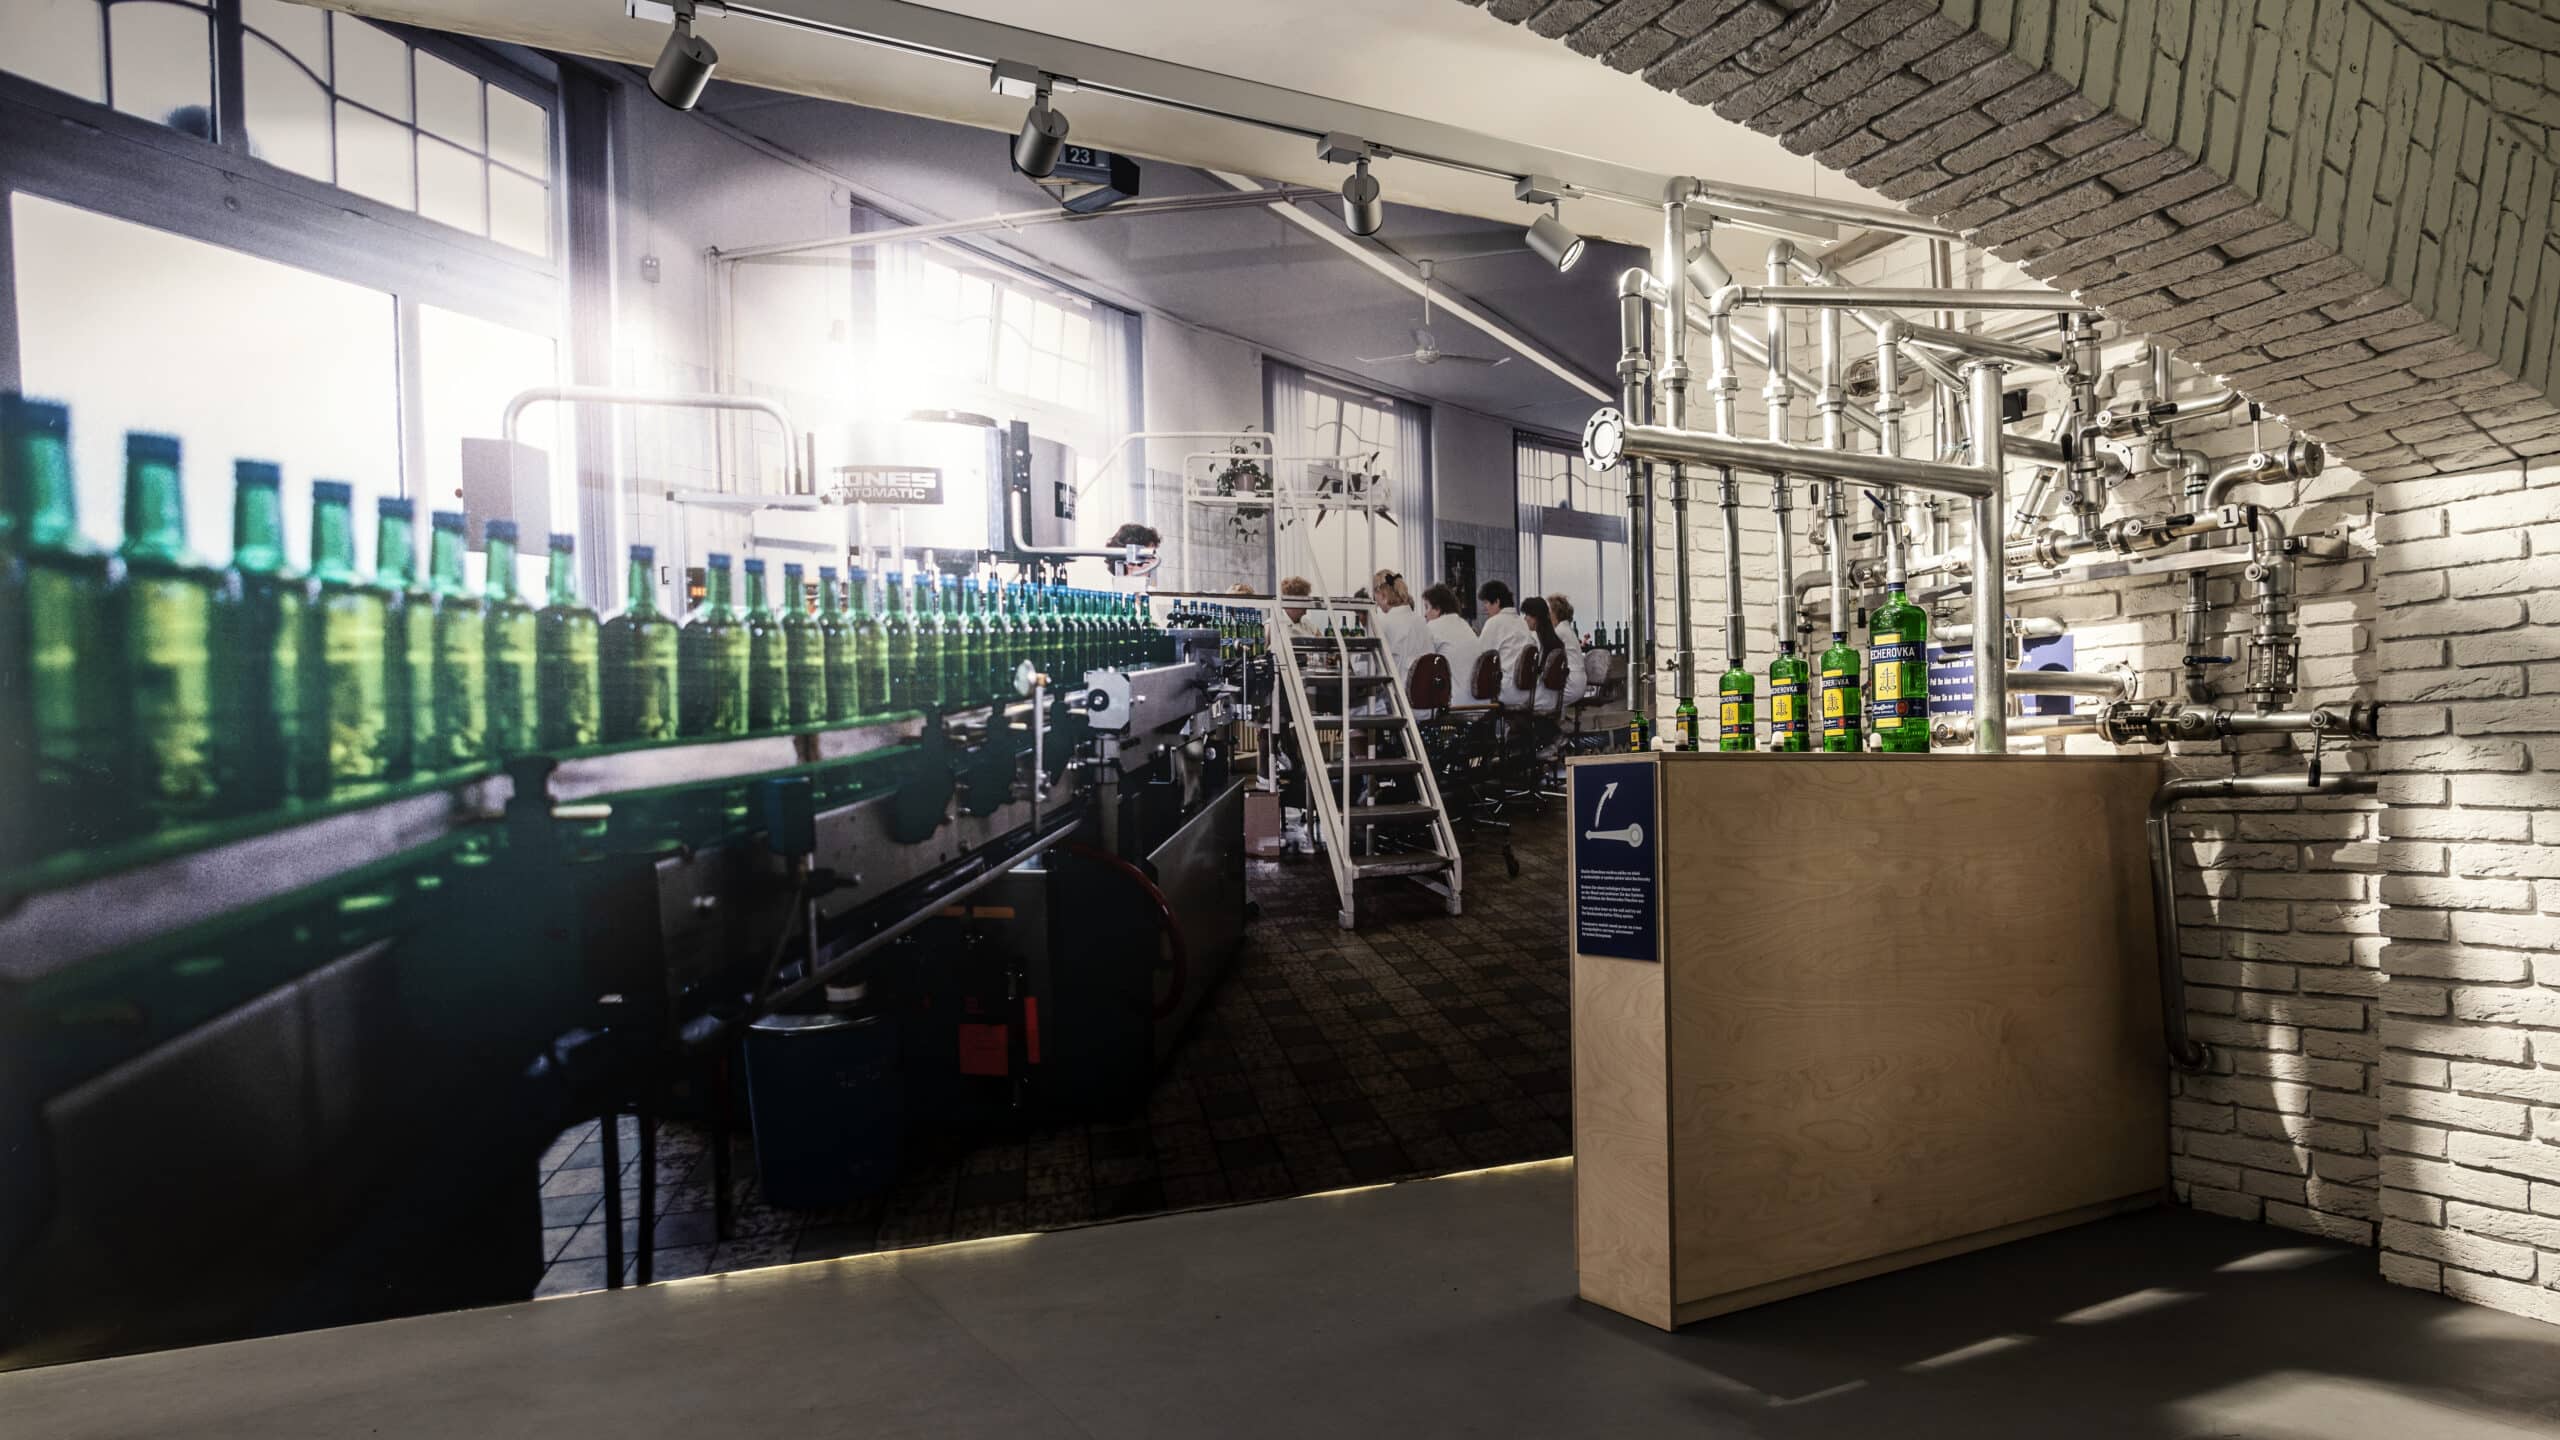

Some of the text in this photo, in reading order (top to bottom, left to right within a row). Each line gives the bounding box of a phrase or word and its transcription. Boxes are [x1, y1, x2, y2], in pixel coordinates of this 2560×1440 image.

[1070, 147, 1090, 164] 23
[2072, 398, 2083, 413] 1
[832, 471, 936, 489] RONES
[831, 487, 926, 499] ONTOMATIC
[2223, 508, 2234, 524] 1
[1870, 646, 1915, 660] ECHEROVKA
